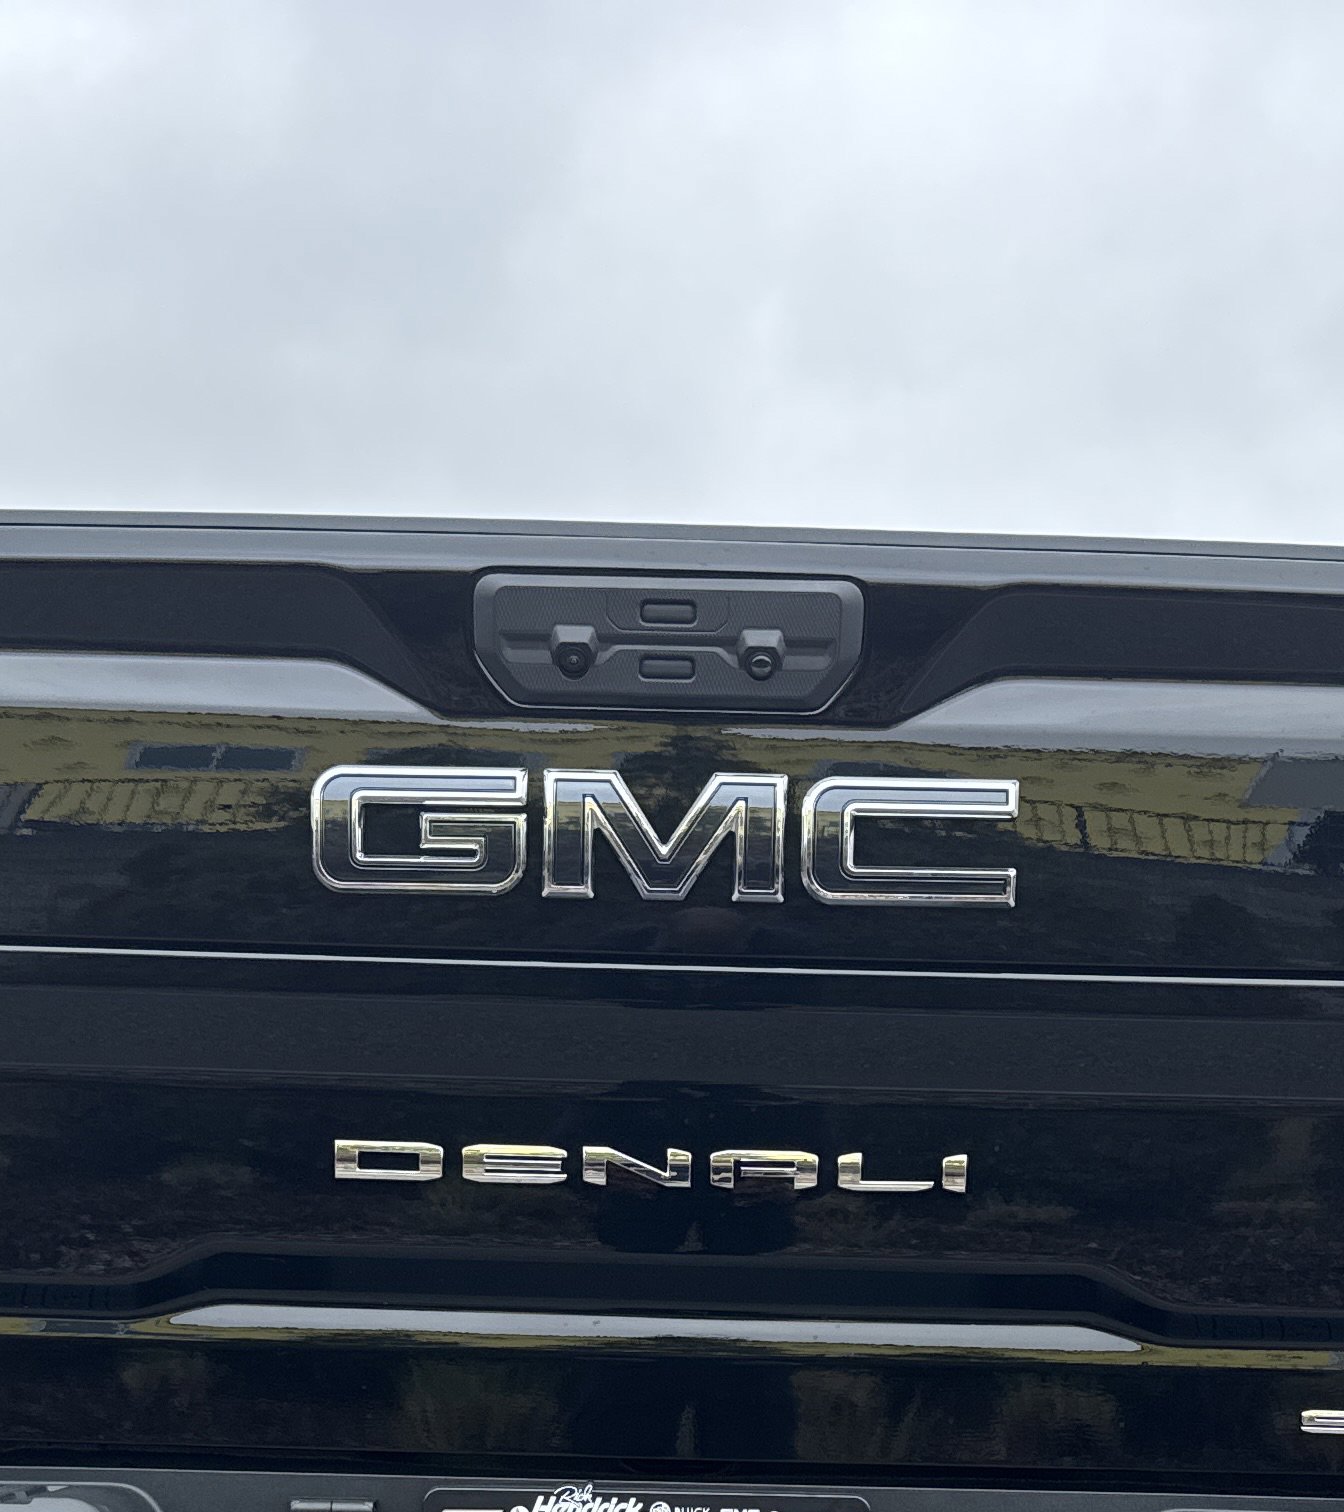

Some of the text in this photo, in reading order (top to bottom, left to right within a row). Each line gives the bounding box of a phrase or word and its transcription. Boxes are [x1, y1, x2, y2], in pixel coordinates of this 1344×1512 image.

[311, 765, 1020, 907] GMC
[334, 1139, 968, 1193] DENALI
[554, 1483, 594, 1505] Rick
